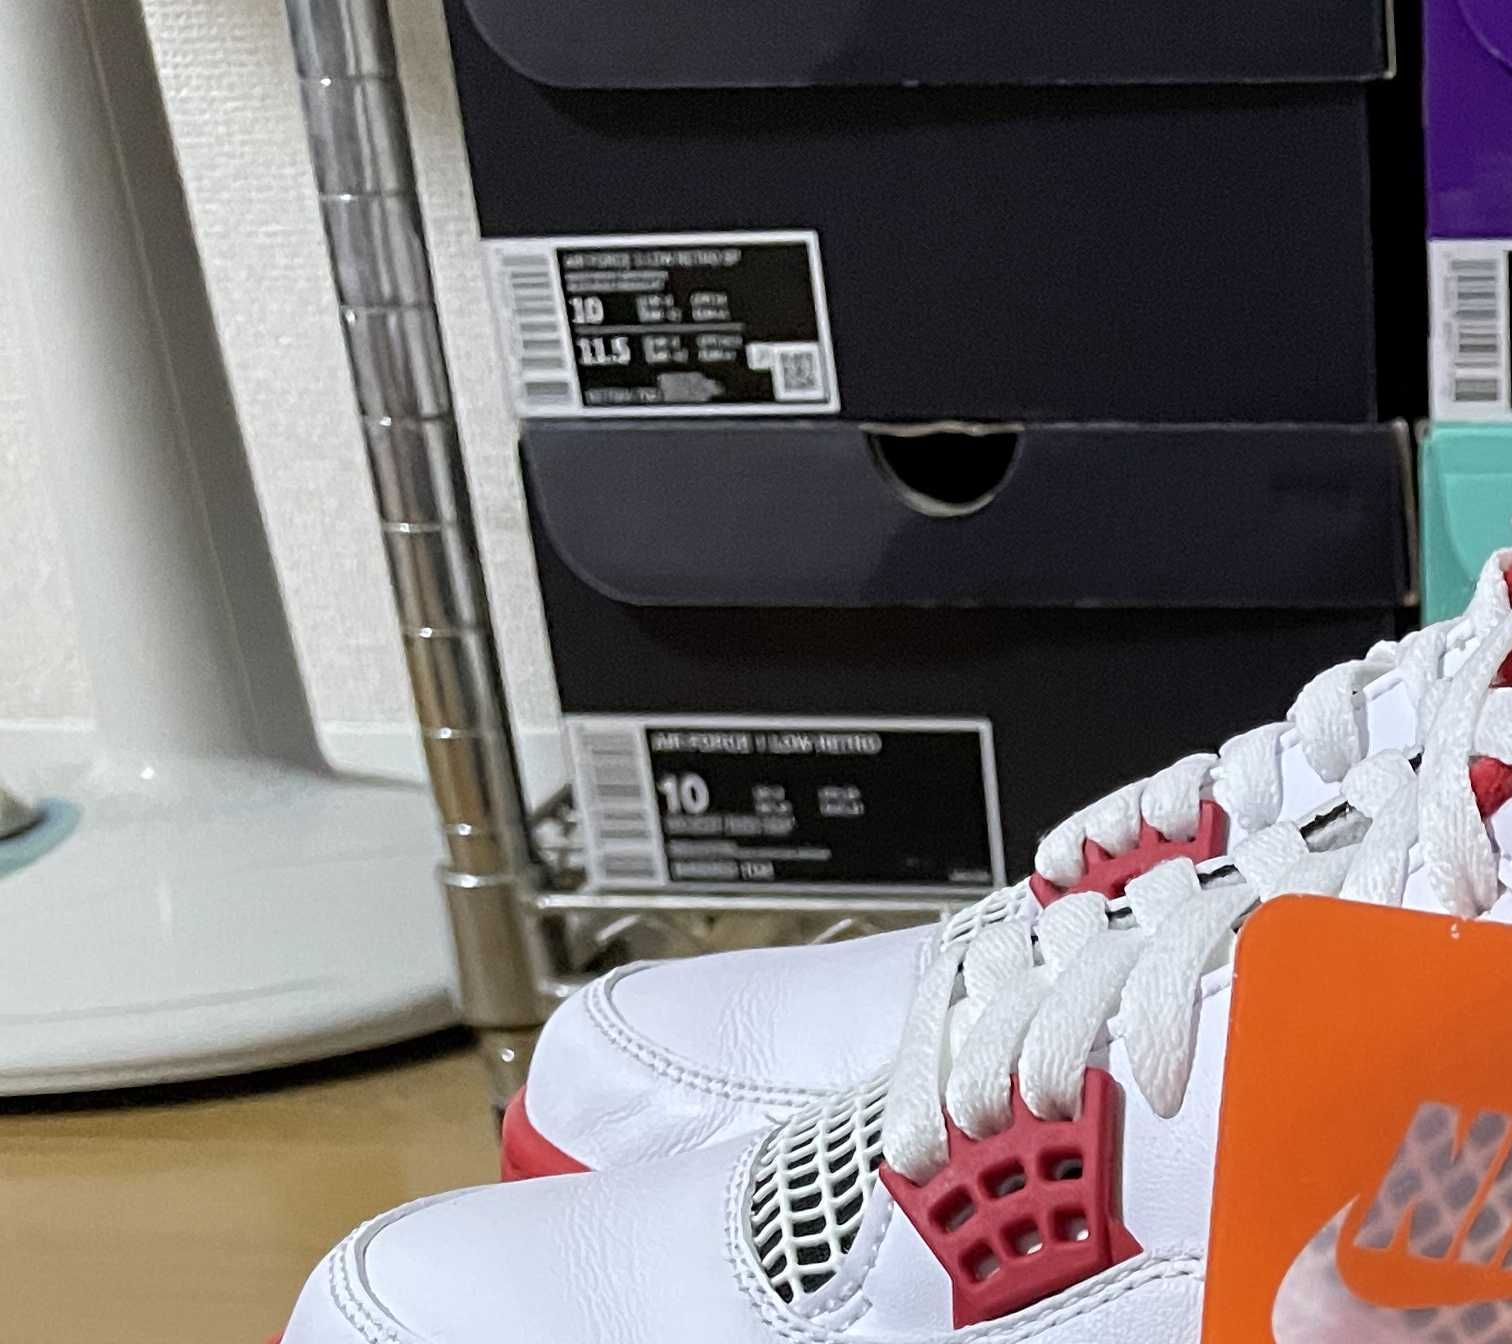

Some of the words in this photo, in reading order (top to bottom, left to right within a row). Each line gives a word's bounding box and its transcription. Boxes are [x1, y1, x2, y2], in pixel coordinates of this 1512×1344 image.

[568, 295, 604, 324] 10
[575, 336, 631, 365] 11.5
[656, 772, 710, 815] 10
